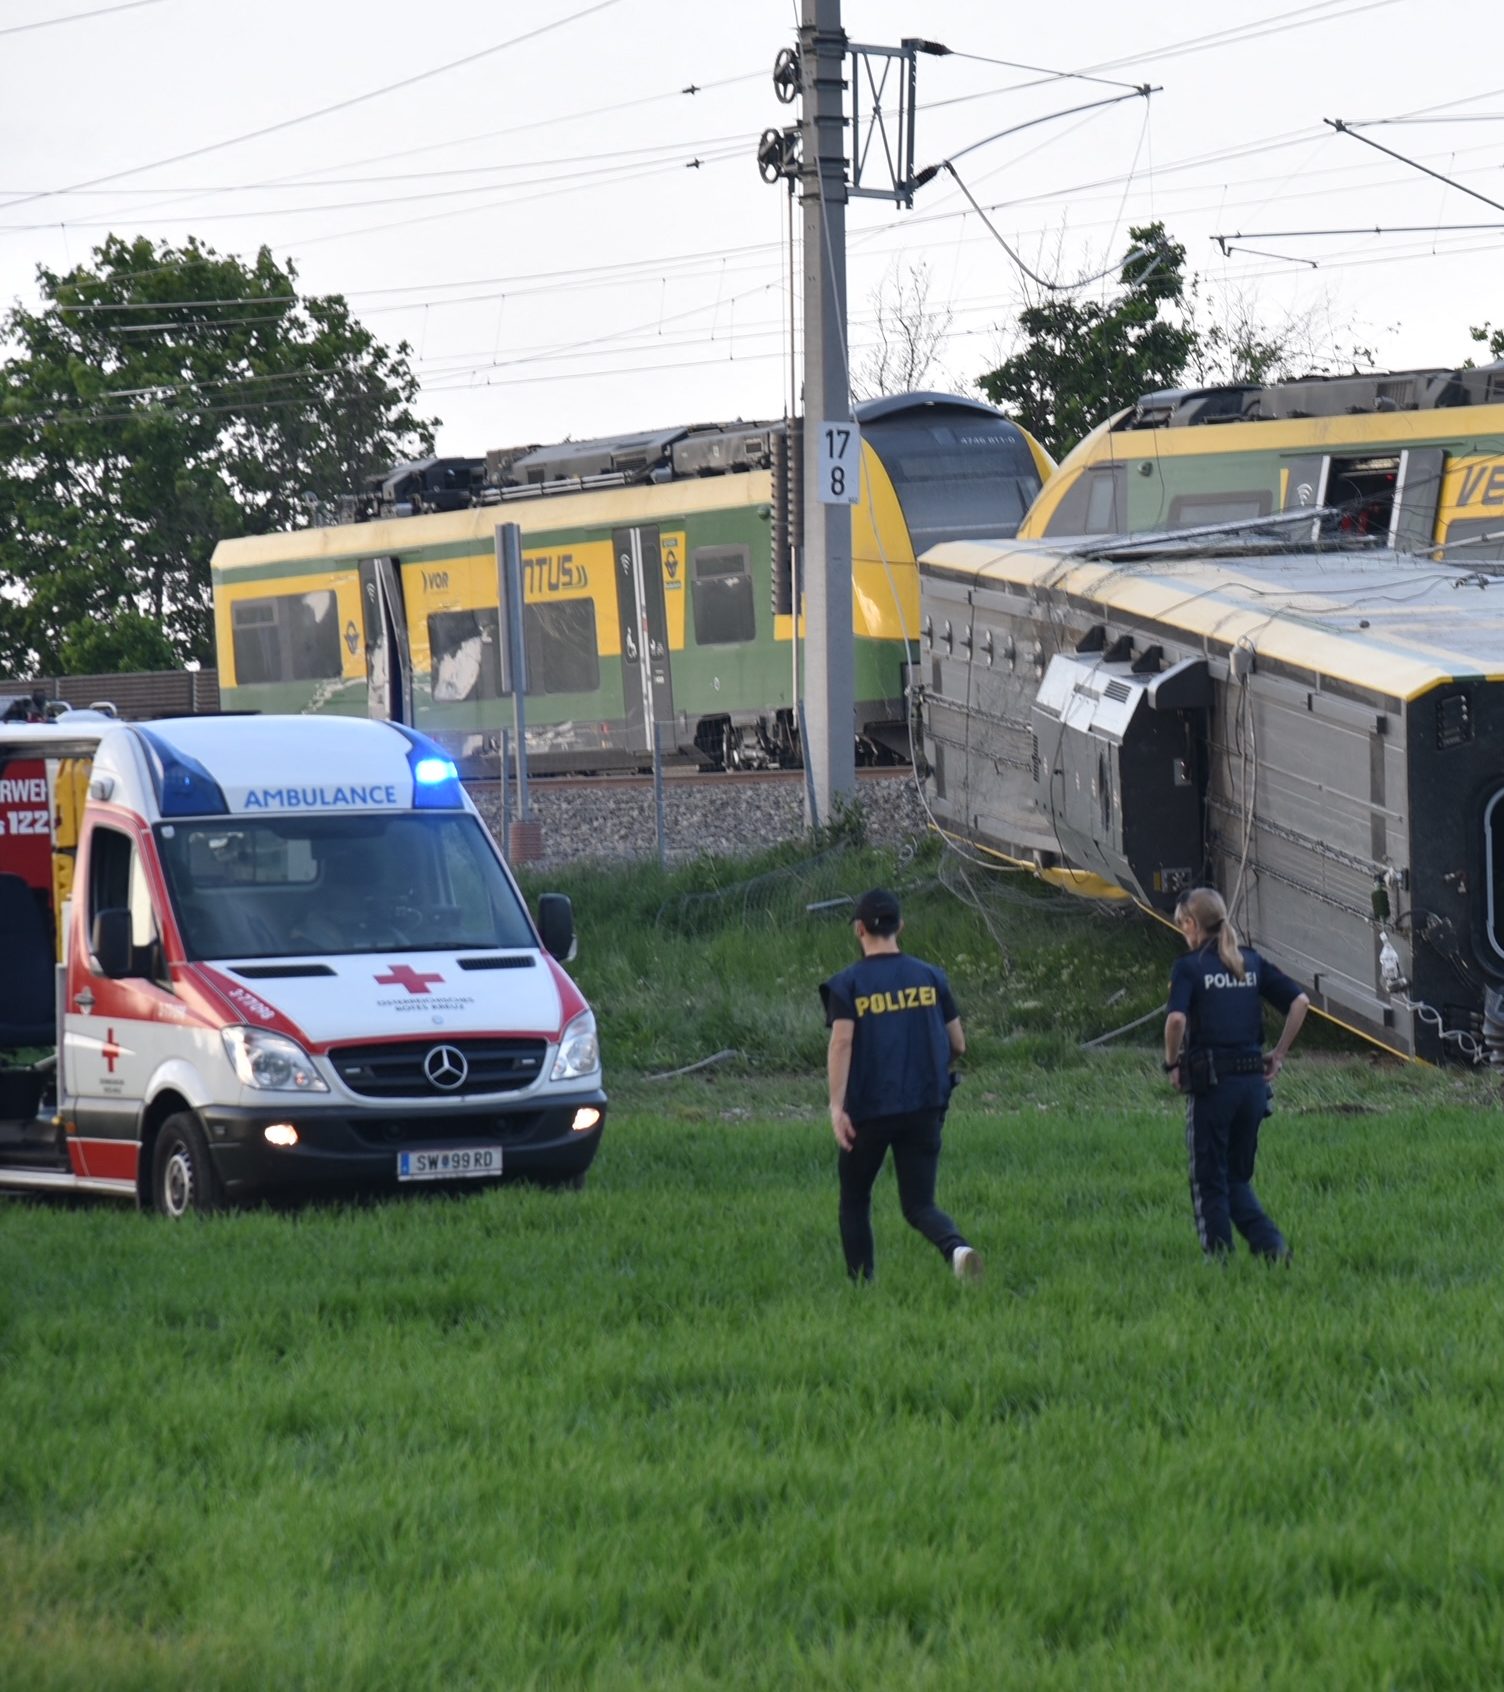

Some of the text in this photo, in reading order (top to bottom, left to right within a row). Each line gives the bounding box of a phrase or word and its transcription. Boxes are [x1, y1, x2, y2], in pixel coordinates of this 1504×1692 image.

[825, 429, 851, 459] 17
[831, 466, 845, 496] 8
[245, 785, 397, 808] AMBULANCE
[7, 810, 50, 835] 122
[855, 986, 937, 1018] POLIZEI
[416, 1151, 493, 1171] SW 99 RD
